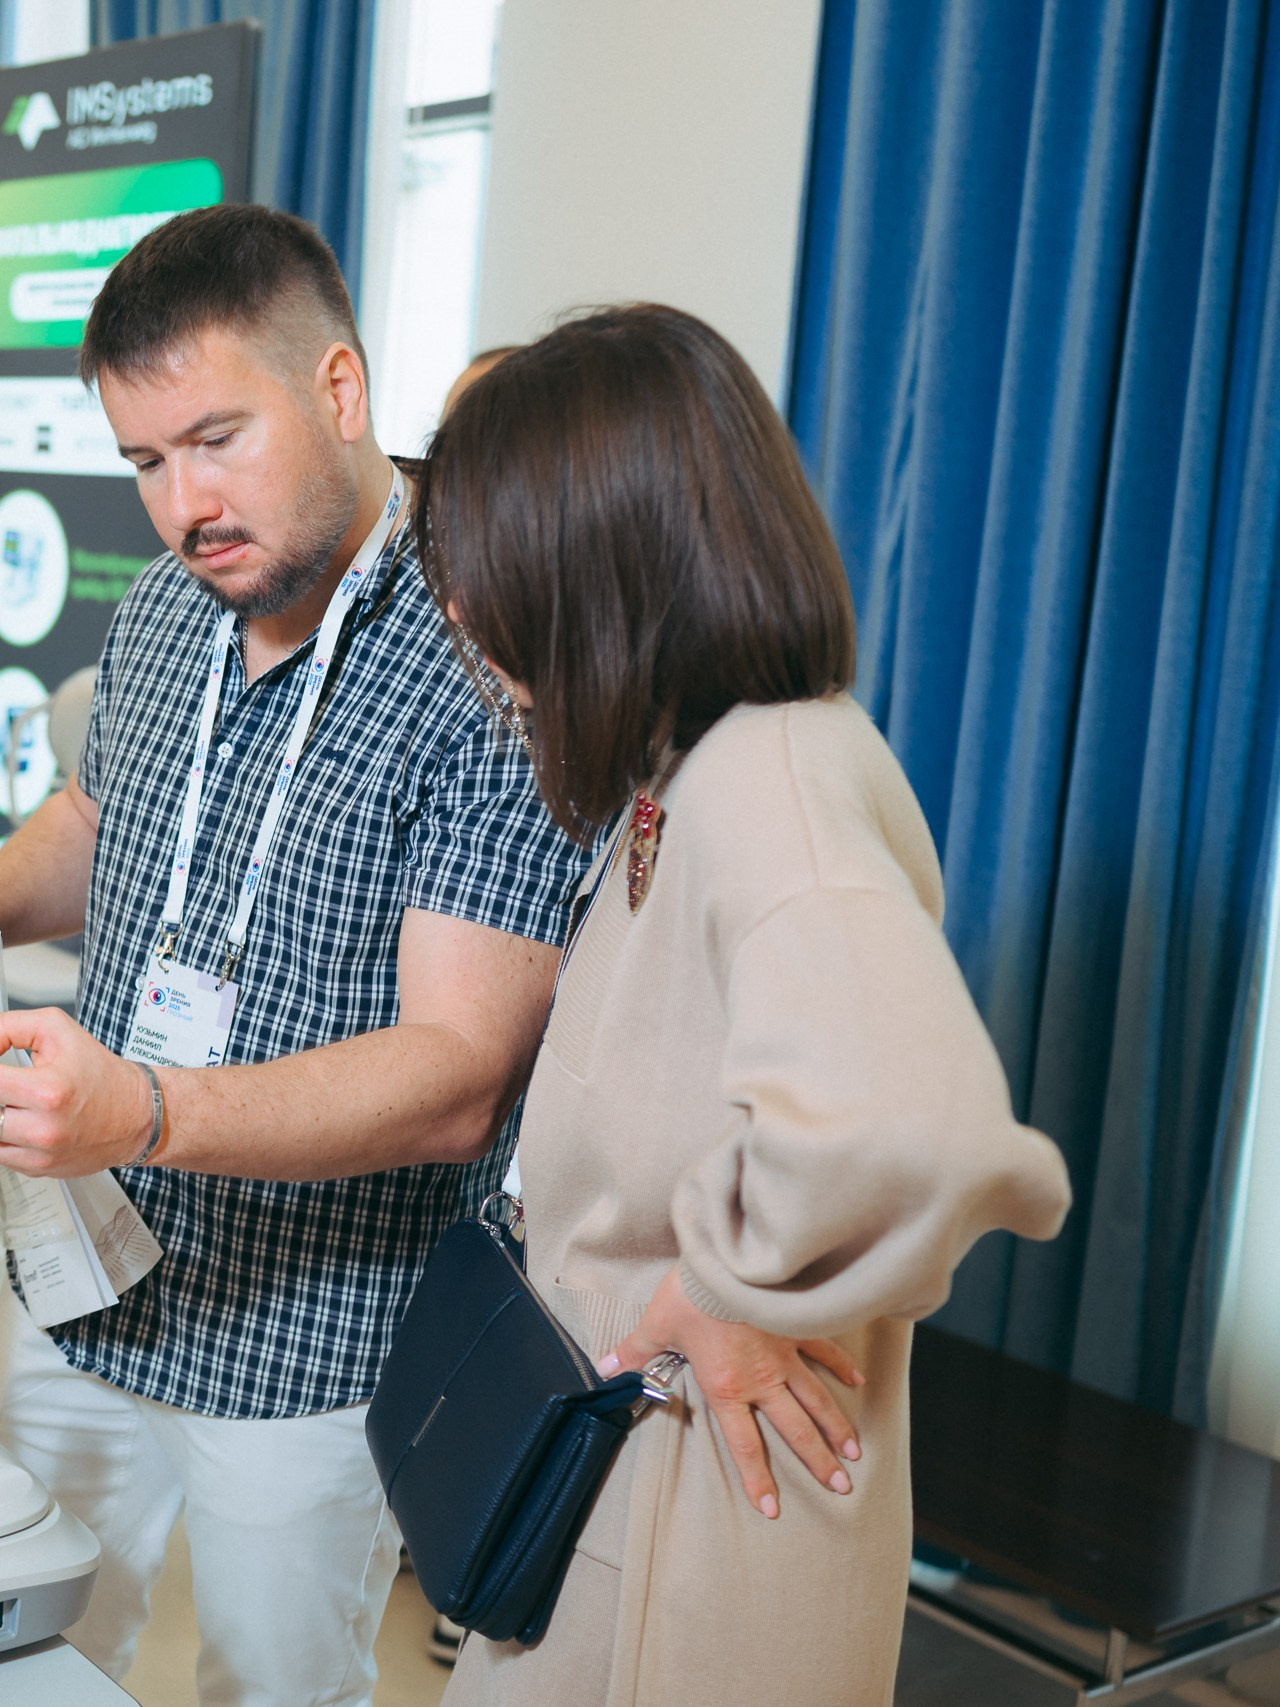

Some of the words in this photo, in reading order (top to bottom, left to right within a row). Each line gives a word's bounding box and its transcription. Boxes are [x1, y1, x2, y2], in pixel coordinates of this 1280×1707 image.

[171, 990, 186, 998] ДЕНЬ
[169, 1002, 181, 1010] 2025
[170, 996, 191, 1007] ЗРЕНИЯ
[137, 1025, 167, 1042] КУЗЬМИН
[133, 1035, 162, 1051] ДАНИИЛ
